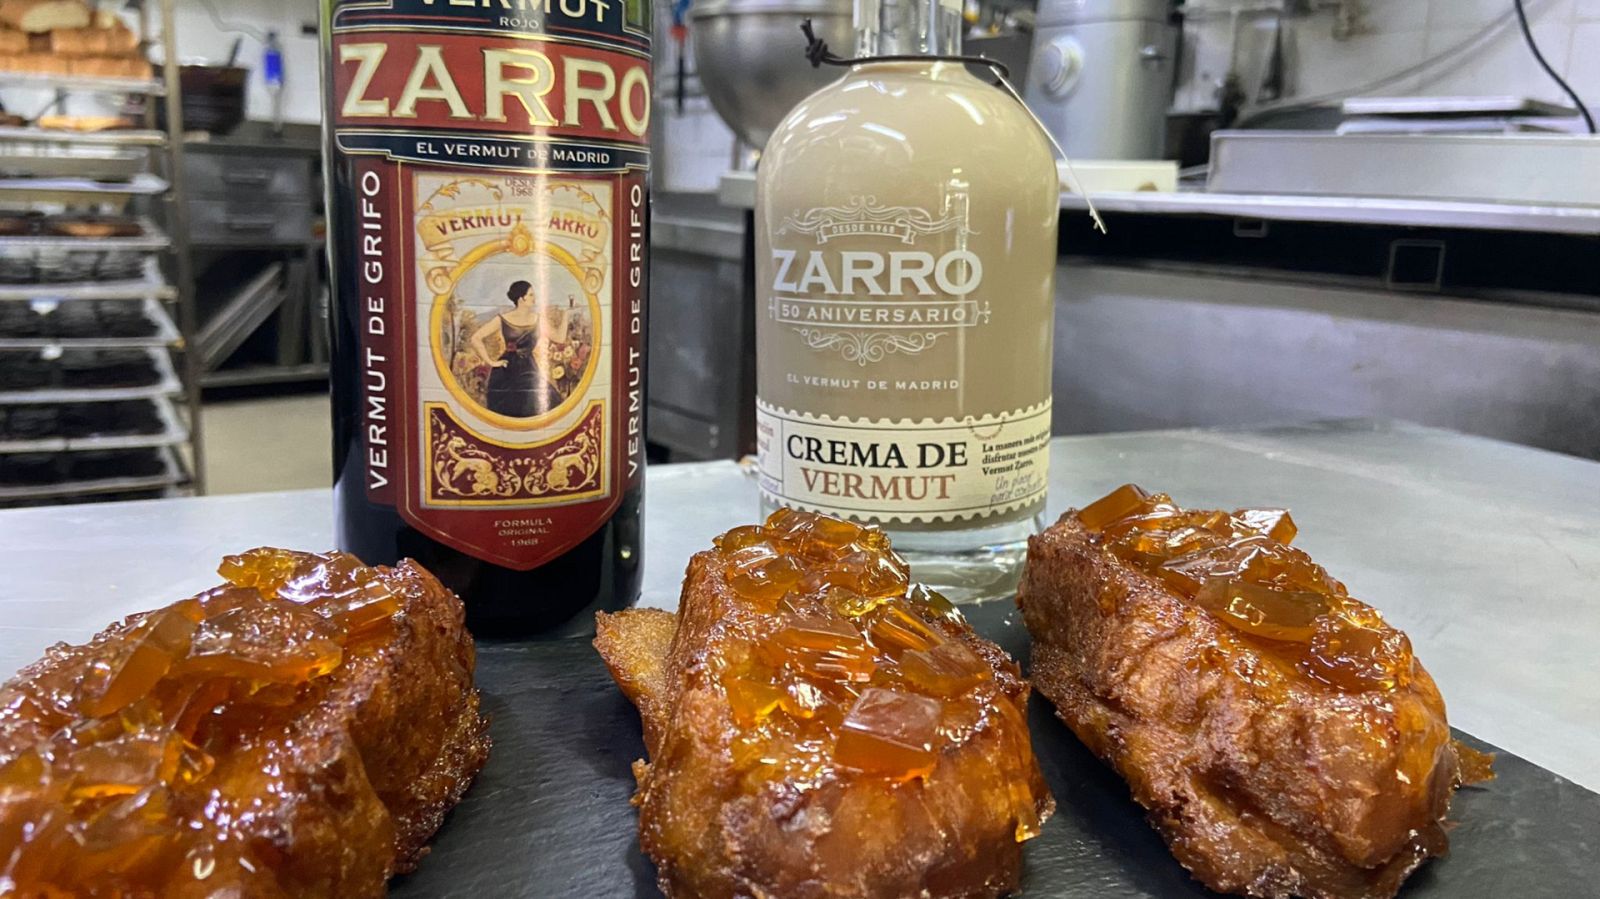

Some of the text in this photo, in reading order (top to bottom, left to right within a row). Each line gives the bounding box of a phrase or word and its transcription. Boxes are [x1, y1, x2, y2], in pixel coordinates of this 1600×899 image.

[499, 16, 540, 29] ROJO
[339, 43, 650, 138] ZARRO
[416, 142, 610, 164] EL VERMUT DE MADRID
[832, 223, 895, 234] DESDE 1968
[771, 249, 983, 295] ZARRO
[782, 304, 966, 322] 50 ANIVERSARIO
[361, 171, 389, 491] VERMUT DE GRIFO
[627, 184, 642, 478] VERMUT DE GRIFO
[787, 373, 960, 390] EL VERMUT DE MADRID
[787, 434, 908, 468] CREMA
[916, 442, 968, 468] DE
[982, 443, 994, 453] La
[800, 467, 956, 500] VERMUT
[494, 518, 553, 528] FORMULA
[498, 527, 551, 537] ORIGINAL
